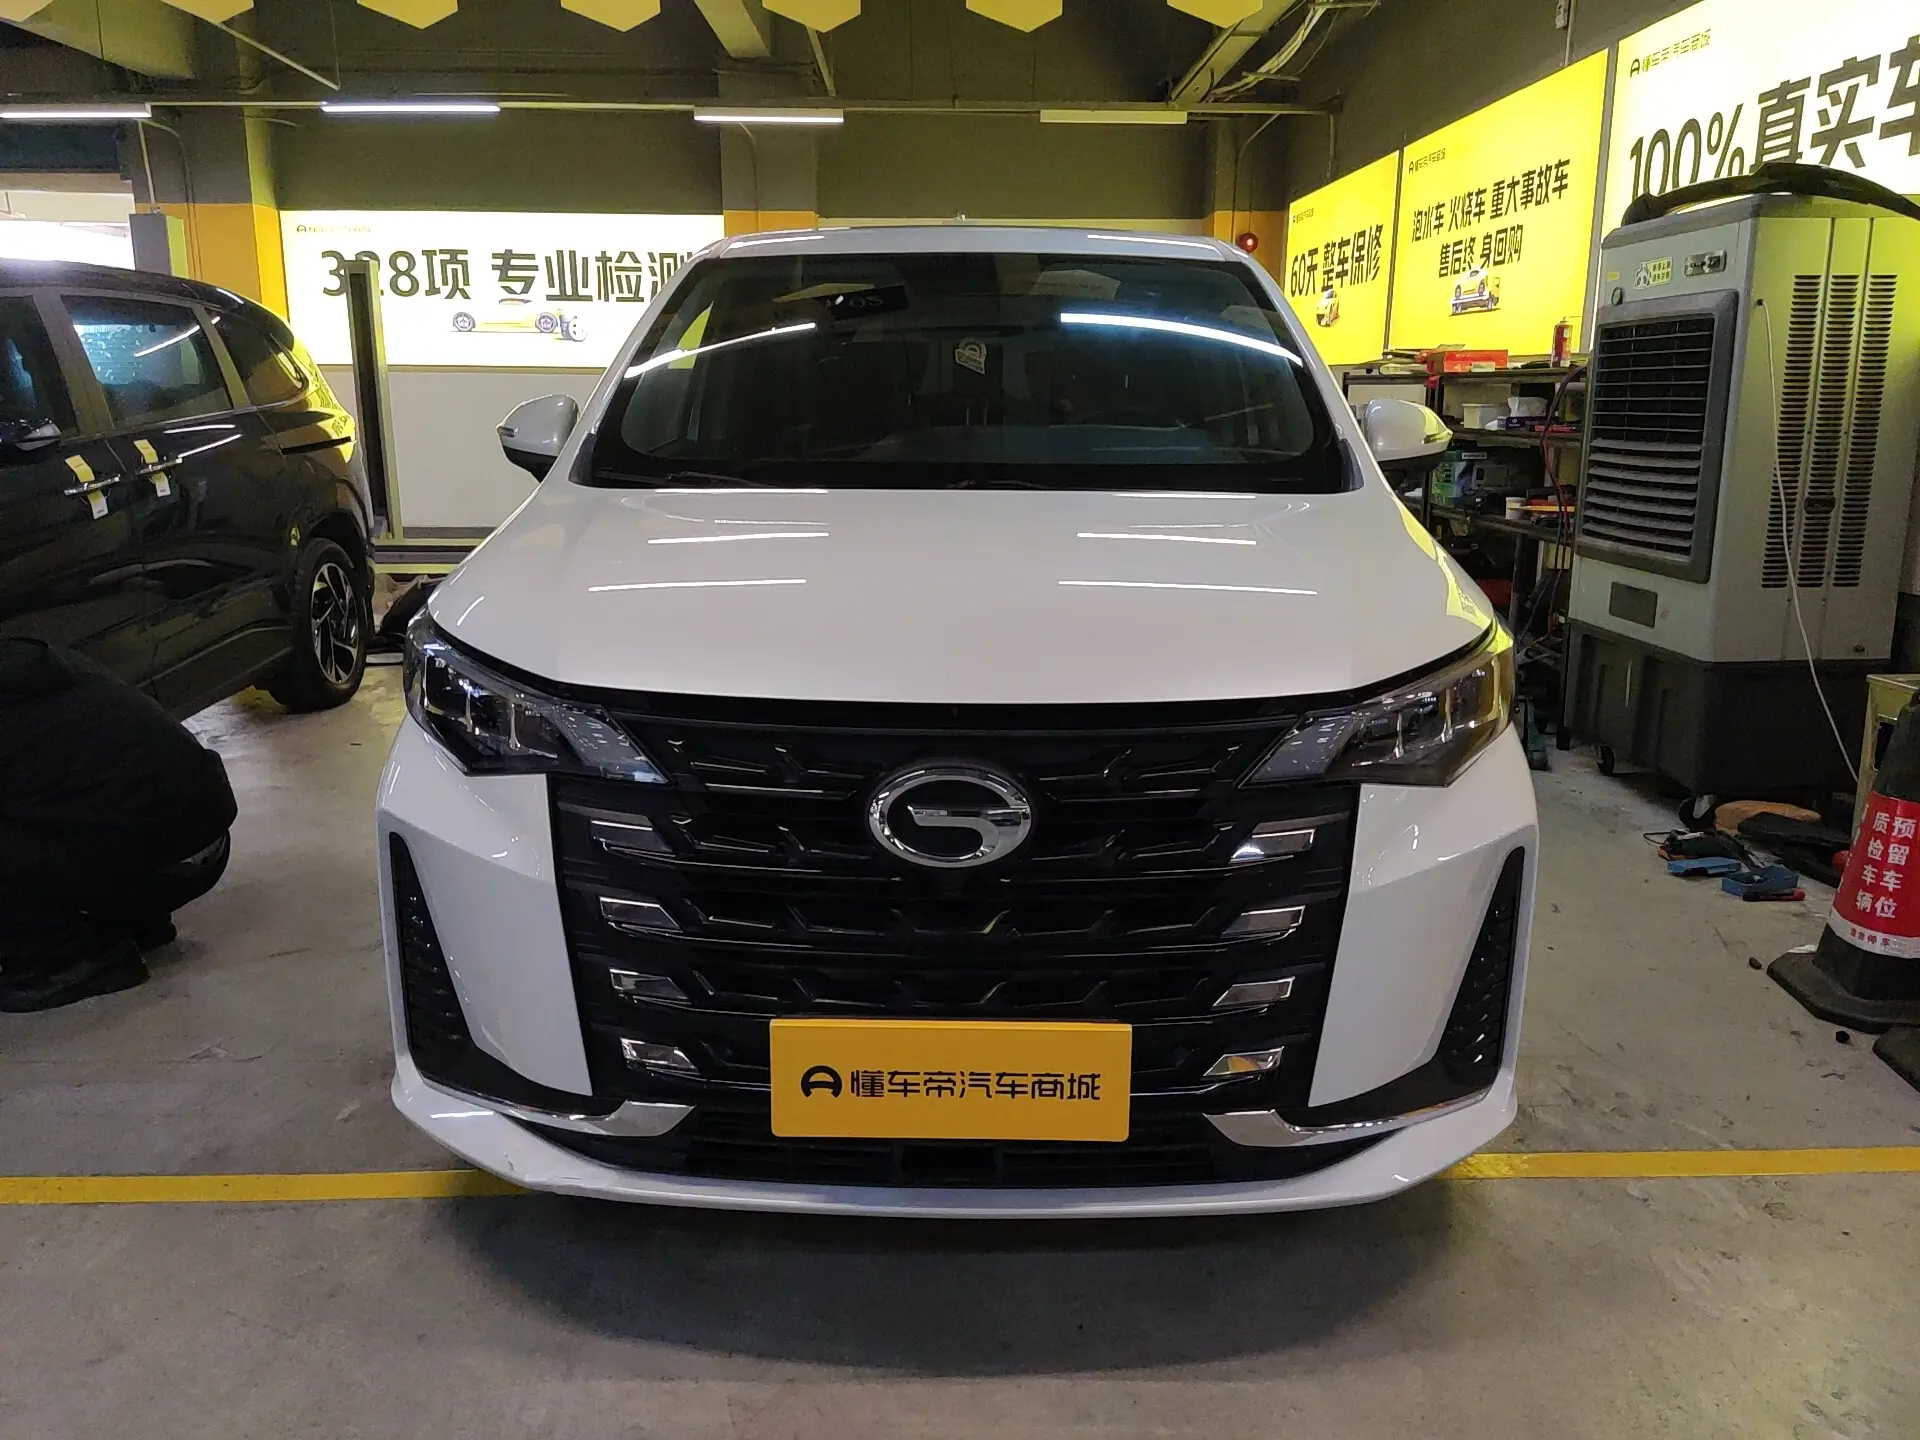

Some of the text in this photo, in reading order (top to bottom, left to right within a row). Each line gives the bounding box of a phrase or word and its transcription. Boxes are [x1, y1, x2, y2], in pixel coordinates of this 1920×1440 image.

[1448, 188, 1487, 232] 火烧车
[1490, 158, 1570, 220] 重大事故车
[1291, 224, 1384, 297] 60天 整车保修
[1856, 812, 1890, 913] 质检车辆
[1874, 816, 1917, 919] 预留车位
[850, 1070, 1101, 1100] 懂车帝汽车商城
